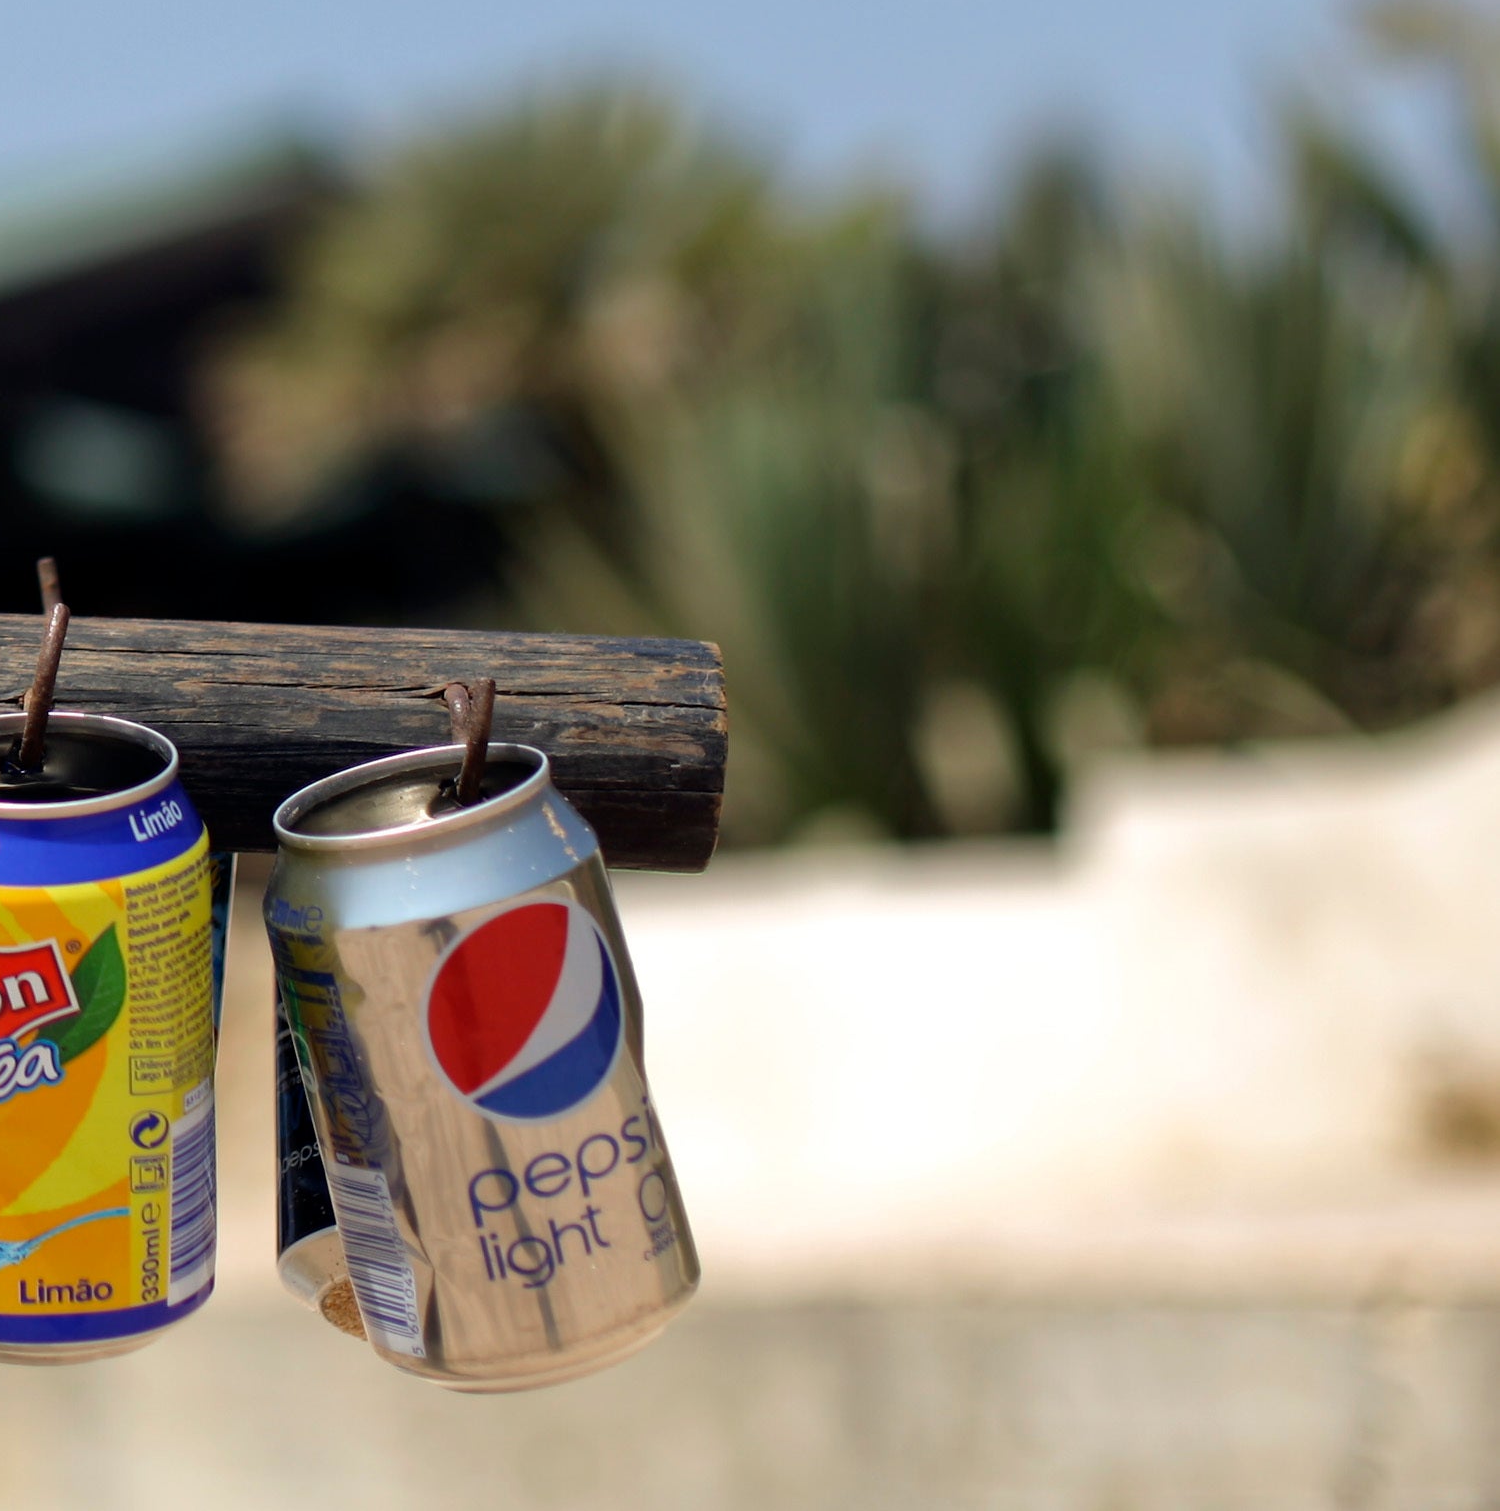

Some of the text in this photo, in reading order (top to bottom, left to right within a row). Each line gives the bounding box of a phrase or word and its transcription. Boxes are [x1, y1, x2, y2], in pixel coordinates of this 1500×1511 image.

[129, 800, 183, 842] Limão
[281, 1141, 320, 1174] peps
[468, 1094, 656, 1228] pepsi
[142, 1229, 160, 1302] 330ml
[478, 1205, 612, 1289] light
[19, 1279, 114, 1304] Limão
